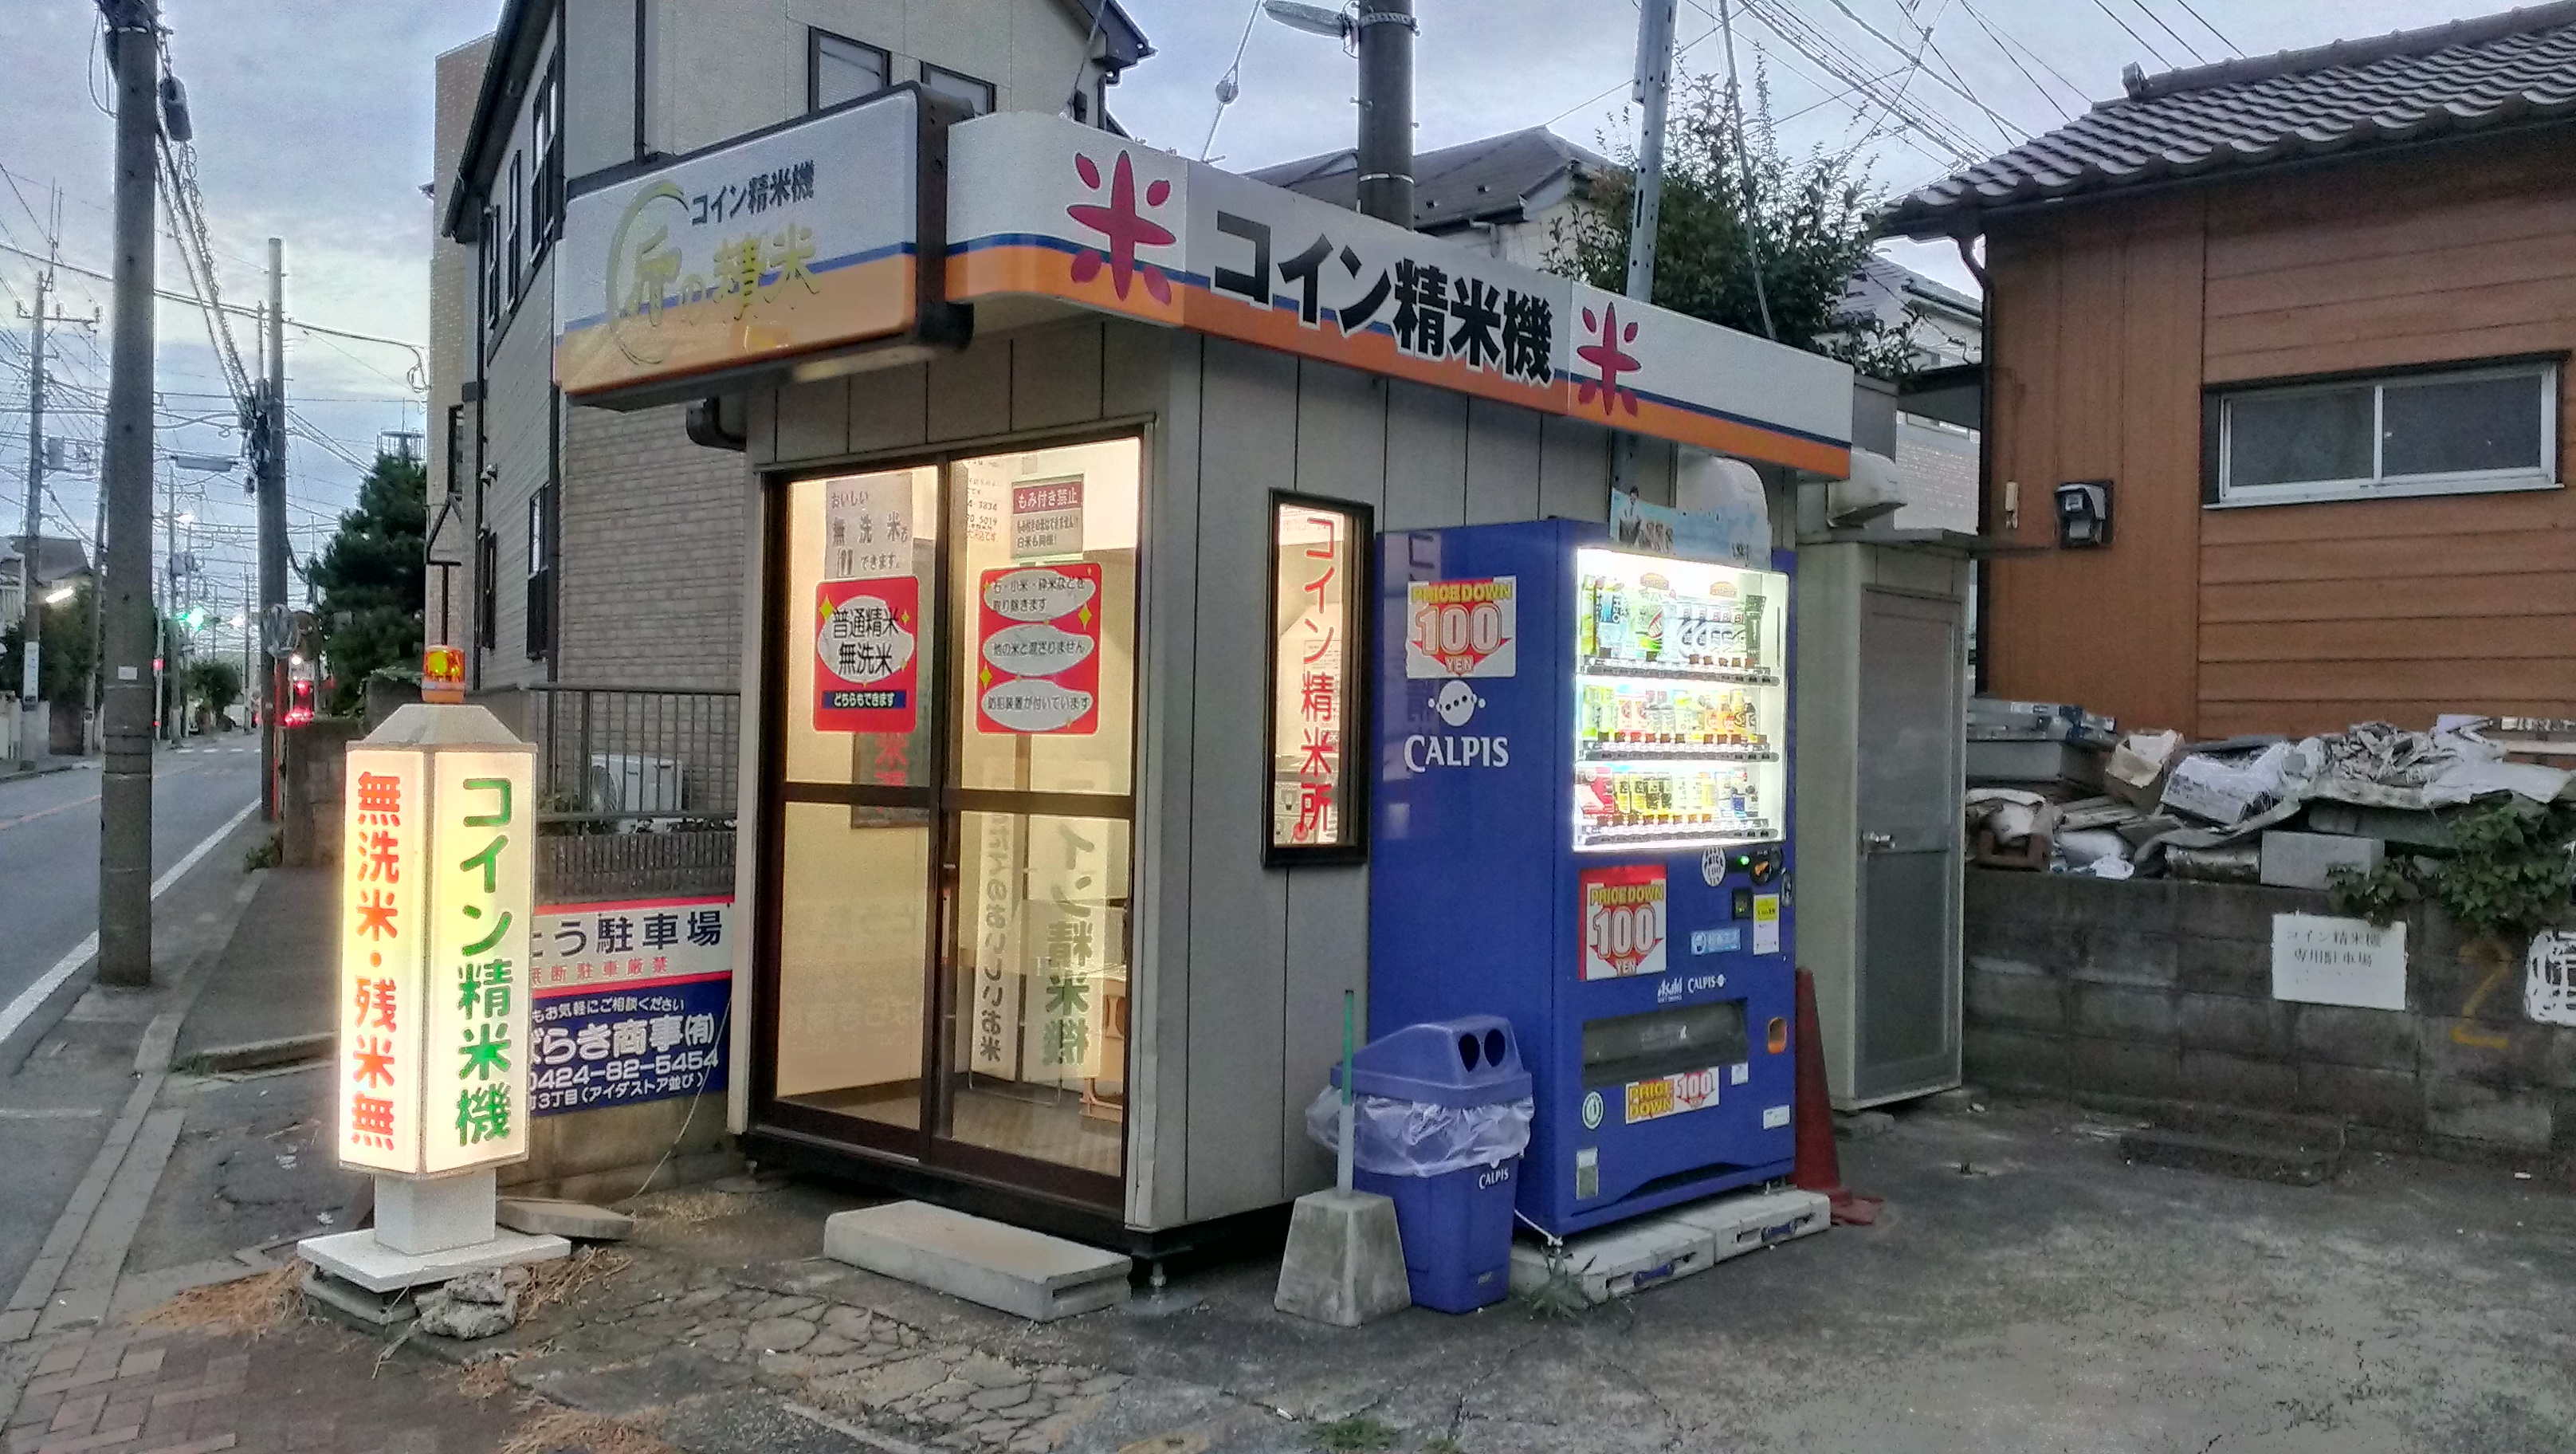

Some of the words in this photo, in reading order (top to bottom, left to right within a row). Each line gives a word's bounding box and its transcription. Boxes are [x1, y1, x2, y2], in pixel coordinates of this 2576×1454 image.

[691, 159, 815, 226] コイン精米機
[1209, 209, 1554, 388] コイン精米機
[831, 490, 868, 509] おいしい
[1018, 487, 1078, 509] もみ付き禁止
[831, 607, 899, 639] 普通精米
[1415, 603, 1502, 656] 100
[838, 642, 893, 676] 無洗米
[1299, 517, 1336, 832] コイン精米所
[1444, 654, 1474, 672] YEN
[834, 691, 895, 708] どちらもできます
[1404, 734, 1510, 772] CALPIS
[1592, 905, 1656, 960] 100
[351, 771, 403, 1151] 無洗米・残米無
[454, 776, 512, 1148] コイン精米機
[1615, 958, 1636, 976] YEN
[1687, 975, 1716, 993] CALPIS
[1675, 1071, 1714, 1099] 100
[1628, 1098, 1673, 1121] DOWN
[1478, 1167, 1510, 1190] CALPIS
